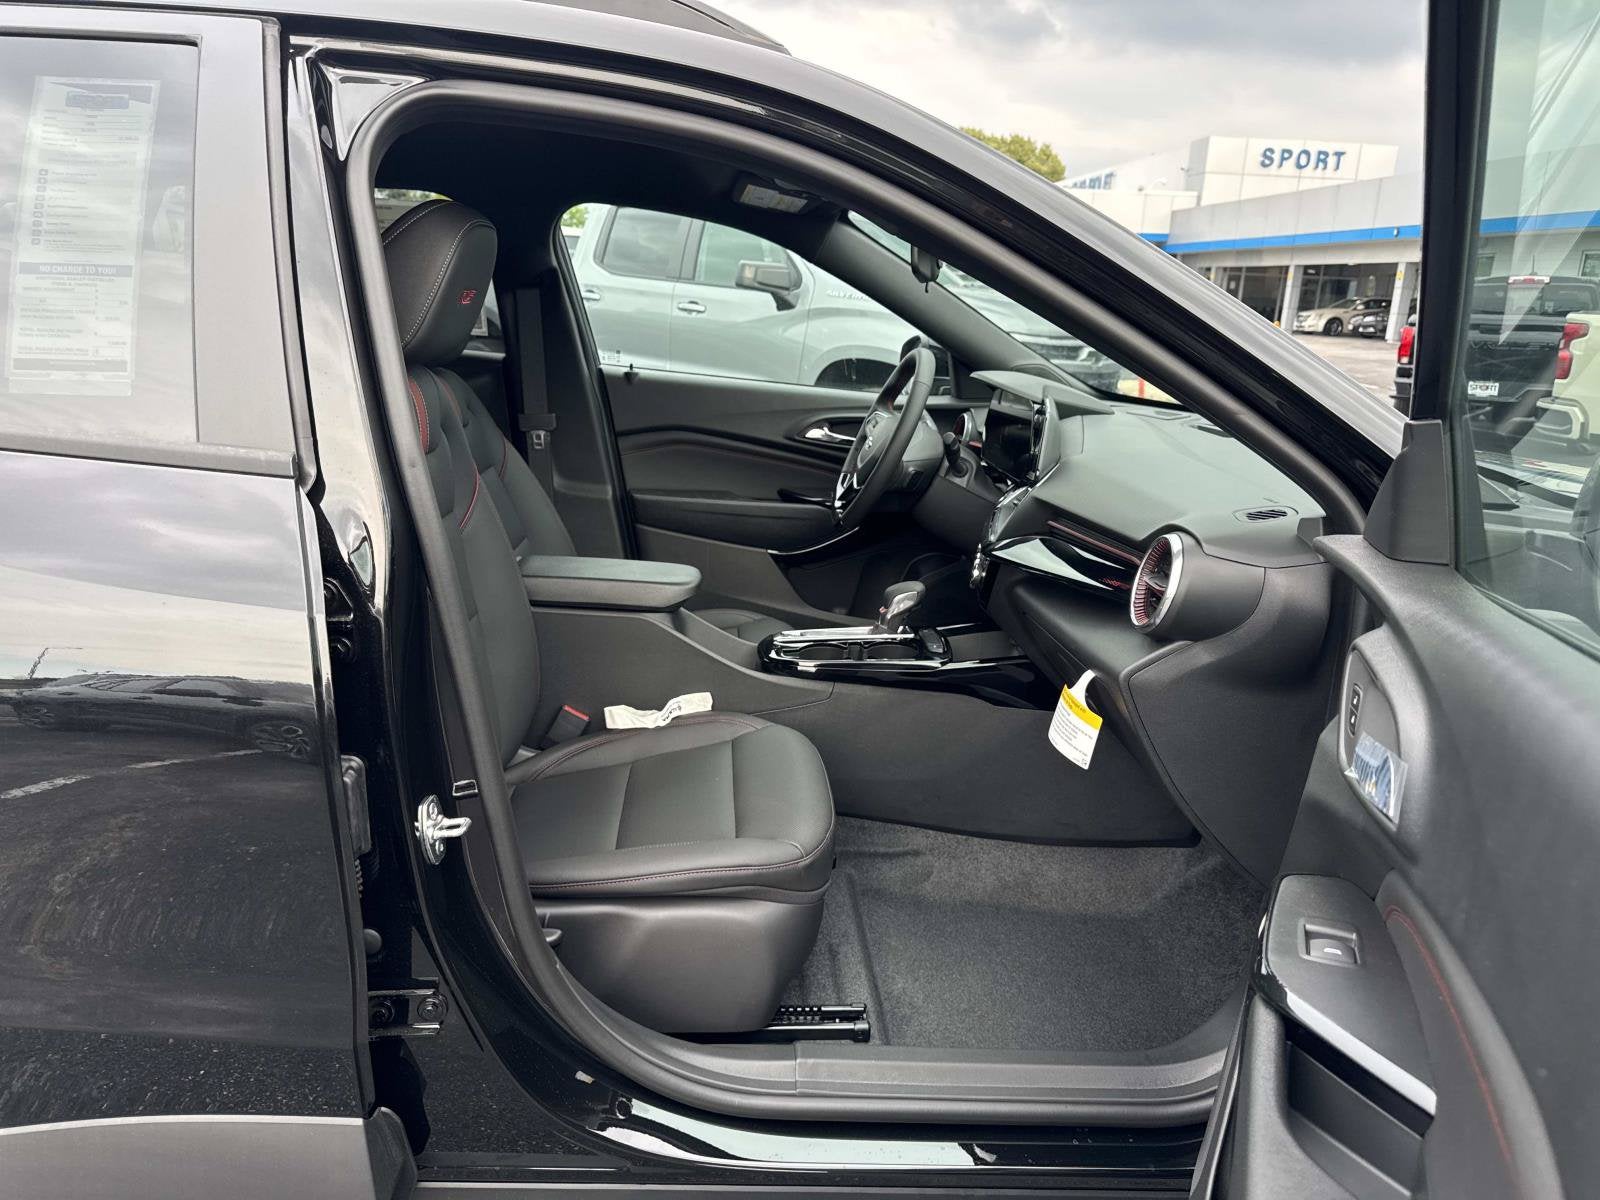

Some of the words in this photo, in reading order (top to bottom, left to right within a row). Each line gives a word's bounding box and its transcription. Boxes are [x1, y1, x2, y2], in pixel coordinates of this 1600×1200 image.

[1260, 147, 1346, 171] SPORT
[40, 264, 50, 272] NO
[85, 265, 96, 273] TO
